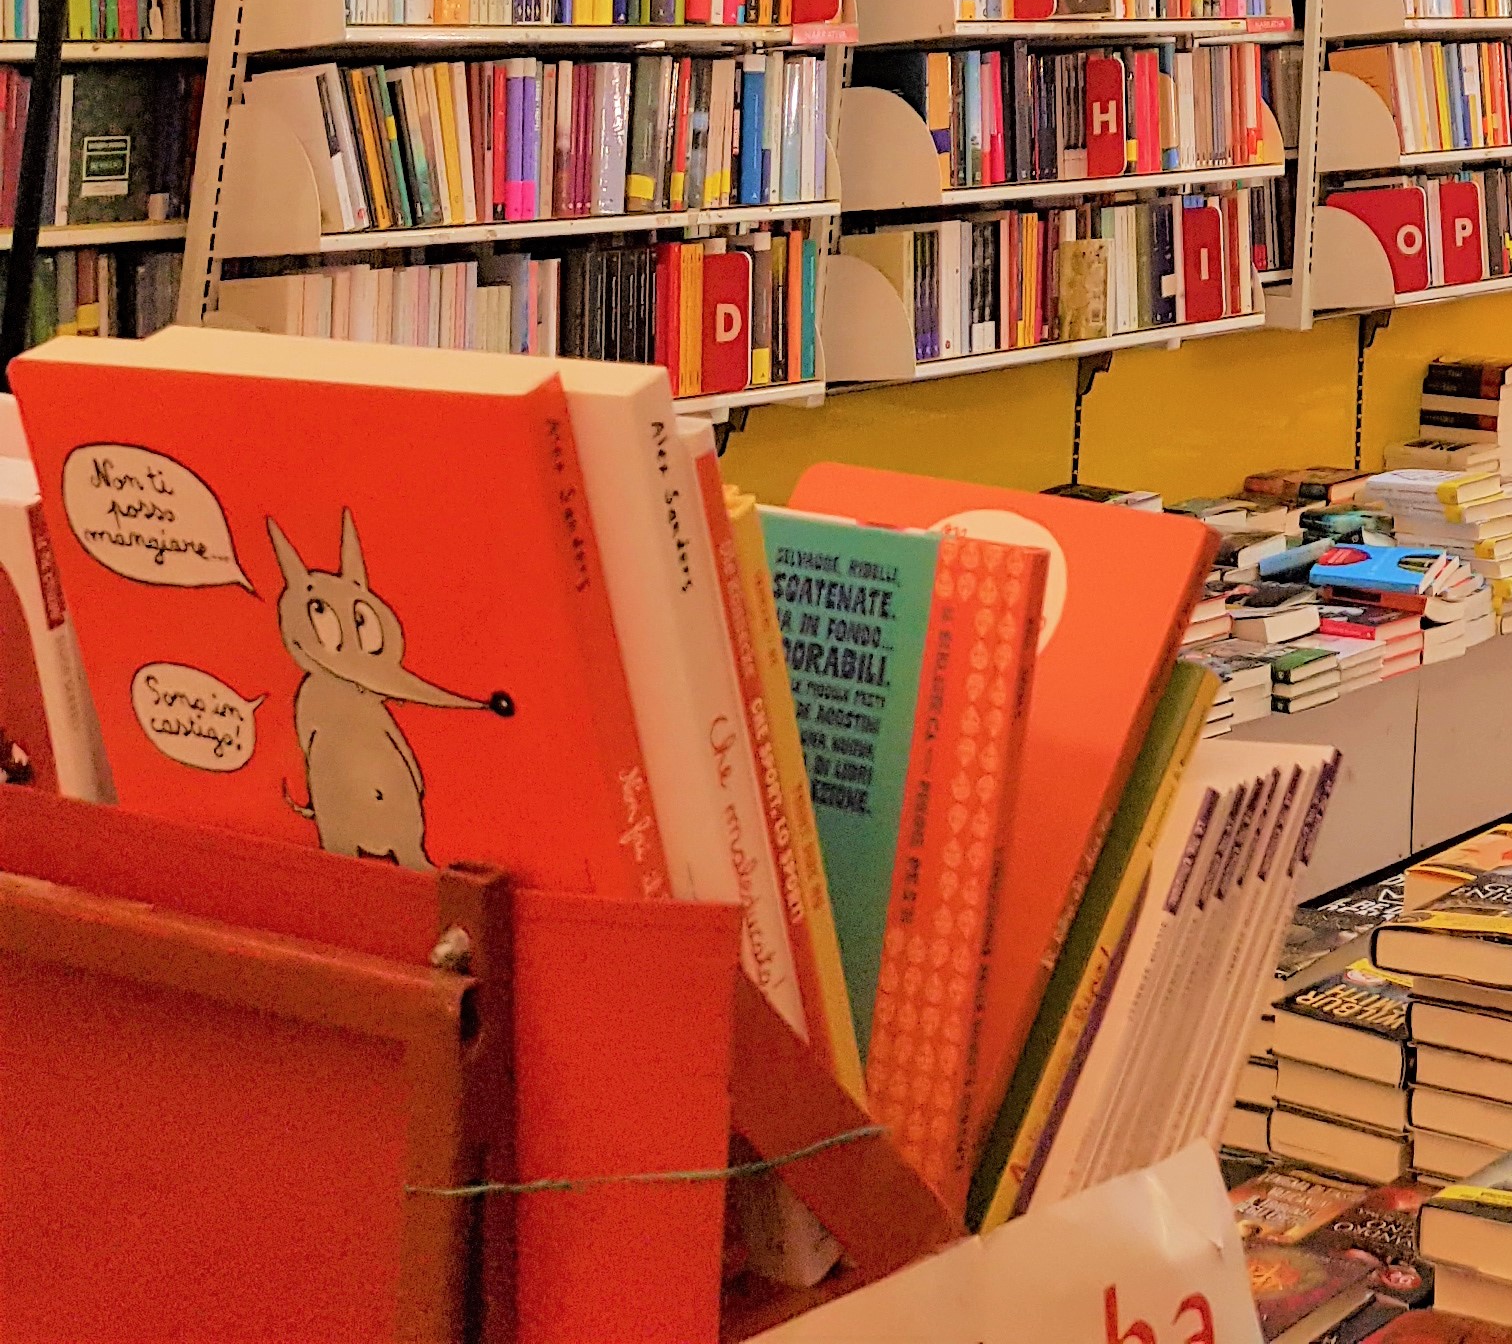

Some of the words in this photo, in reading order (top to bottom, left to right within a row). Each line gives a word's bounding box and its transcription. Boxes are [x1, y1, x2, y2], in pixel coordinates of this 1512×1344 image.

[1092, 99, 1119, 136] H
[1397, 224, 1423, 256] O
[1455, 217, 1473, 247] P
[716, 303, 743, 343] D
[90, 458, 142, 494] Non
[147, 468, 175, 496] ti
[107, 498, 177, 532] posso
[664, 489, 694, 594] Sanders
[144, 674, 206, 713] Sono
